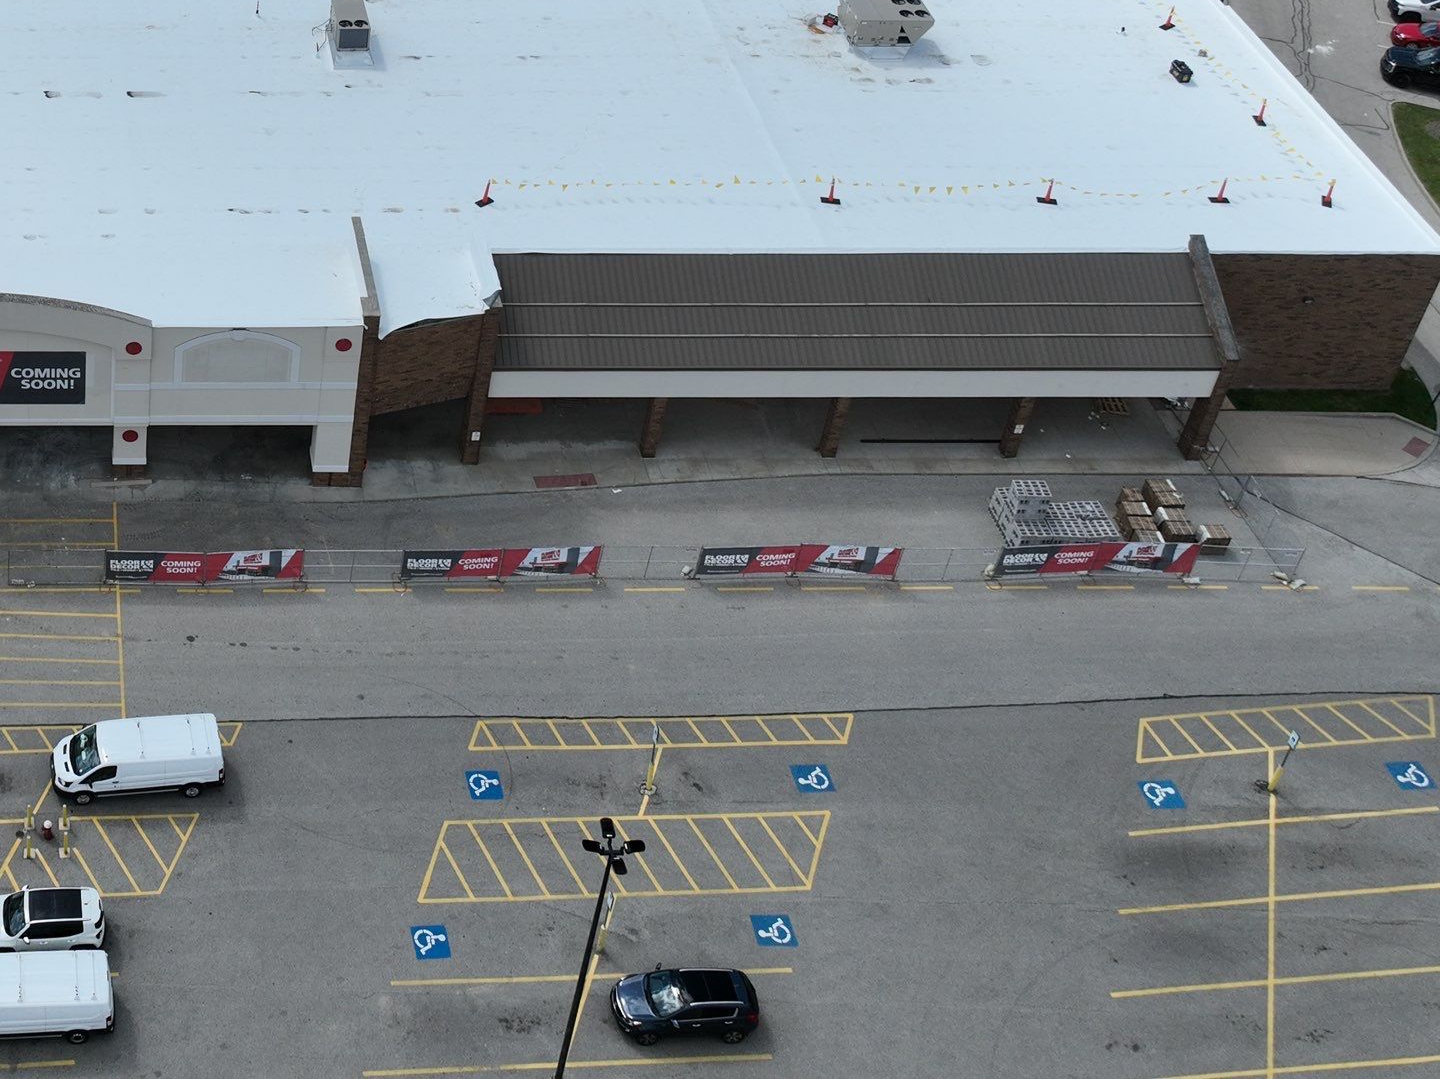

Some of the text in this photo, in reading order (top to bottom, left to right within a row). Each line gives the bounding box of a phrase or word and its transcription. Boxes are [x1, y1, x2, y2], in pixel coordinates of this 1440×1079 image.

[10, 367, 81, 379] COMING
[20, 379, 75, 390] SOON!
[755, 552, 796, 561] COMING
[1054, 550, 1095, 559] COMING
[160, 560, 202, 568] COMING
[458, 556, 499, 565] COMING
[760, 558, 791, 567] SOON!
[1057, 557, 1089, 565] SOON!
[463, 562, 494, 571] SOON!
